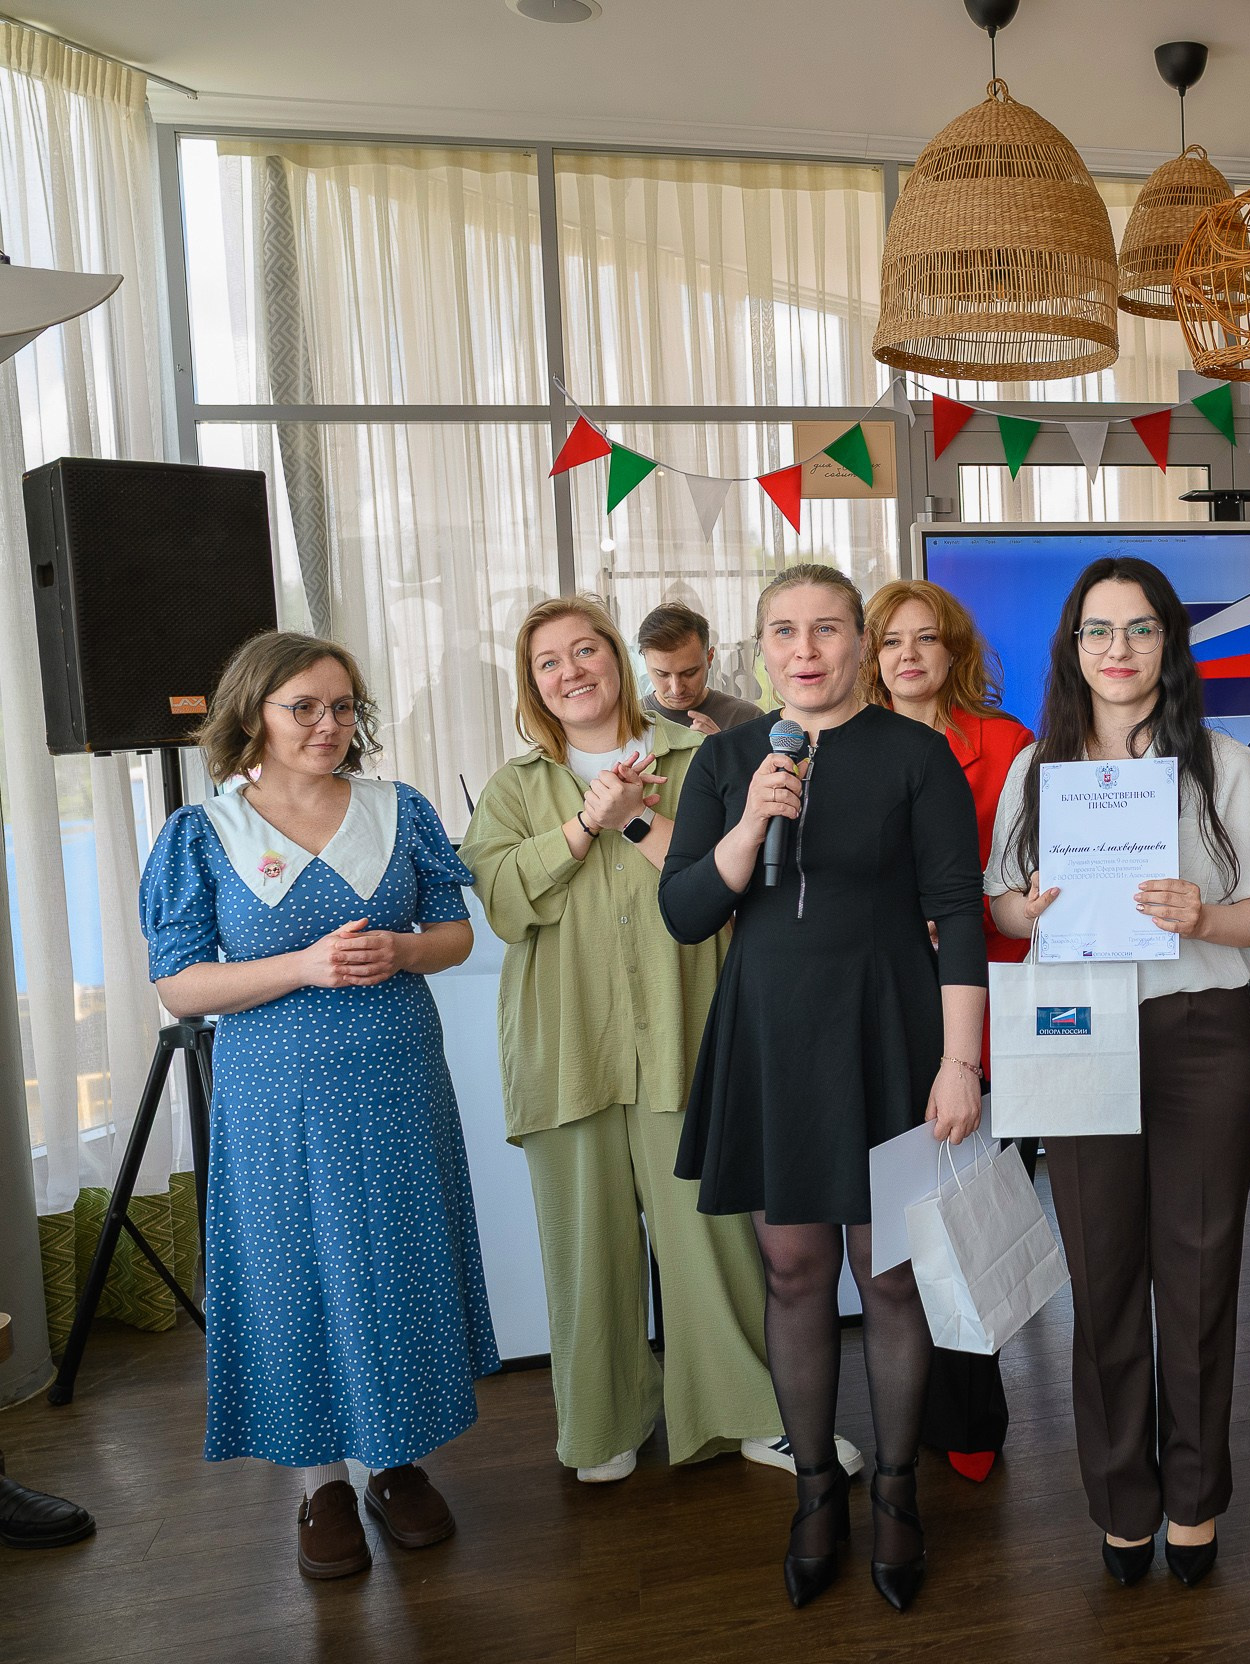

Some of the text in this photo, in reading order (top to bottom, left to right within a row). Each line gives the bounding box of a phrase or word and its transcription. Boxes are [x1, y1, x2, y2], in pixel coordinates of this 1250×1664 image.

[1061, 790, 1156, 802] БЛАГОДАРСТВЕННОЕ
[1088, 800, 1128, 810] ПИСЬМО
[1049, 844, 1091, 856] Карина
